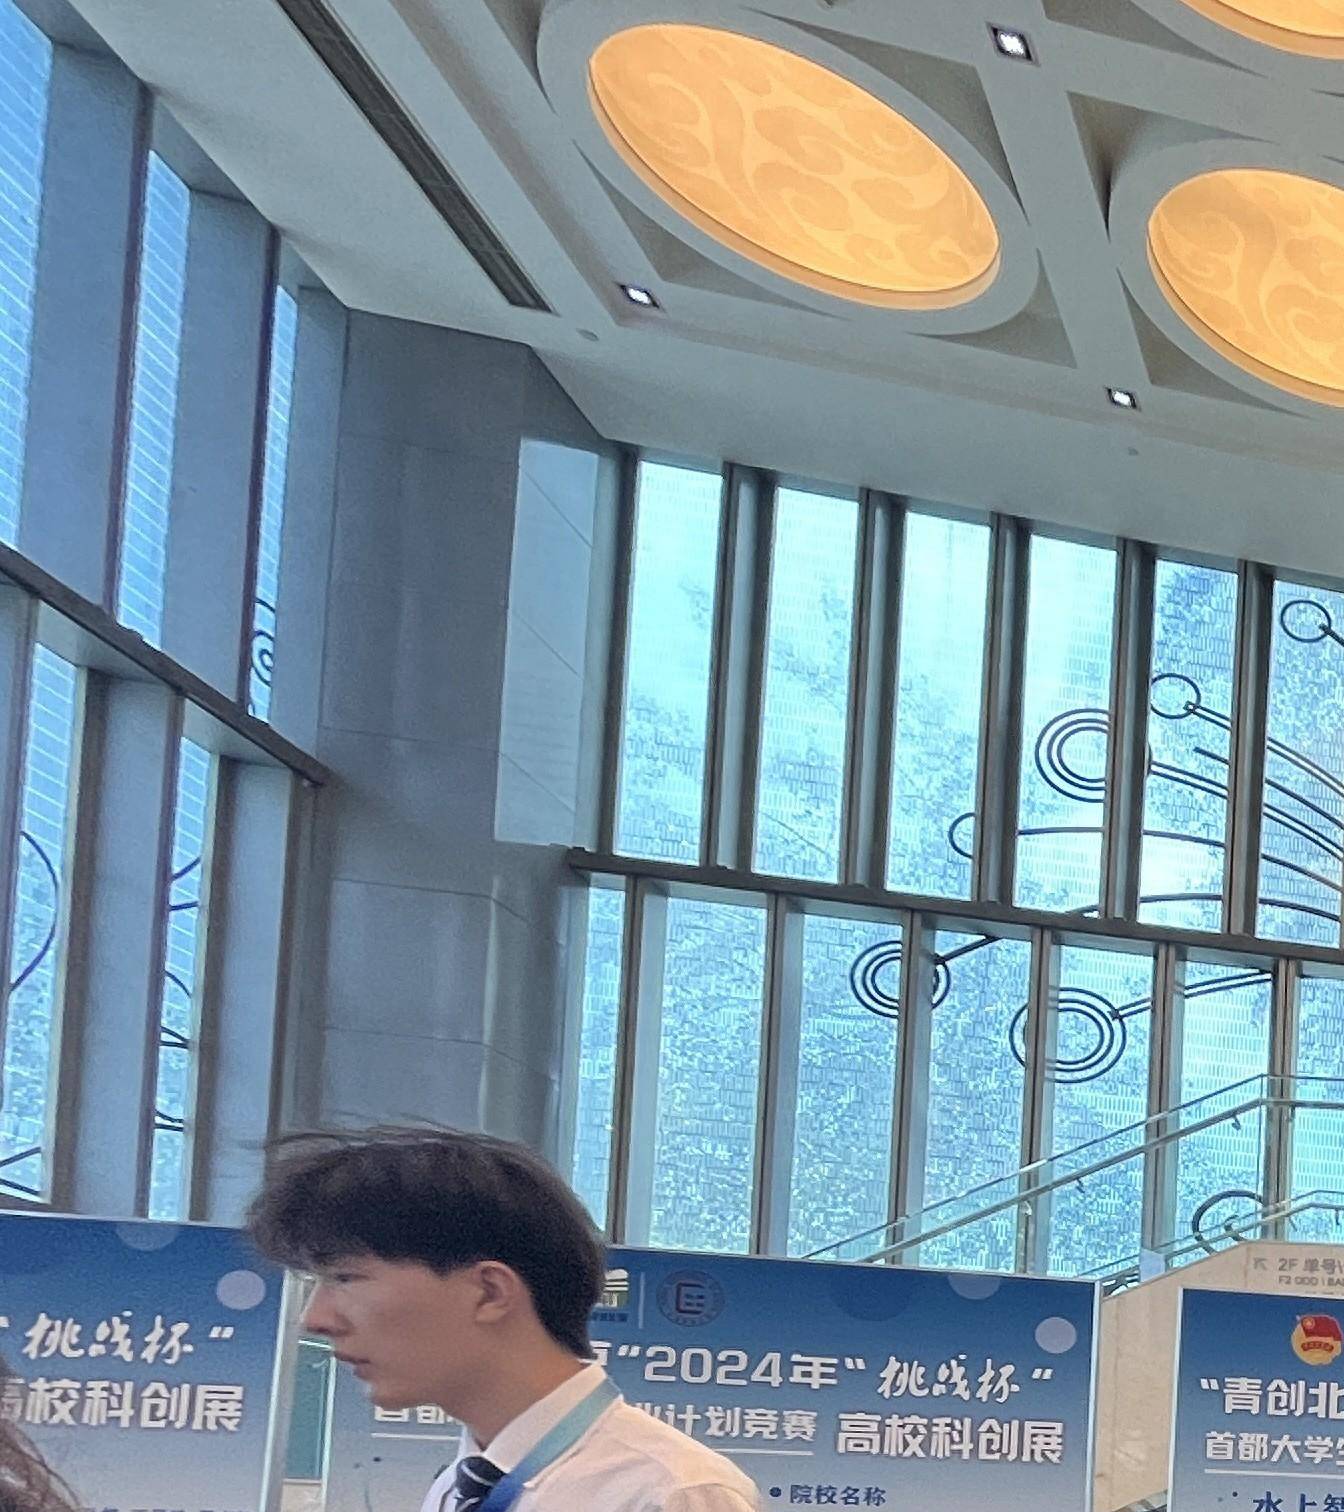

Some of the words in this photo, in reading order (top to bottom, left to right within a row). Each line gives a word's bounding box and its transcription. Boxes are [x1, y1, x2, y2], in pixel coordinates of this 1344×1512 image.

[1278, 1258, 1298, 1272] 2F
[836, 1410, 1065, 1465] 高校科创展
[789, 1484, 887, 1507] 院校名称
